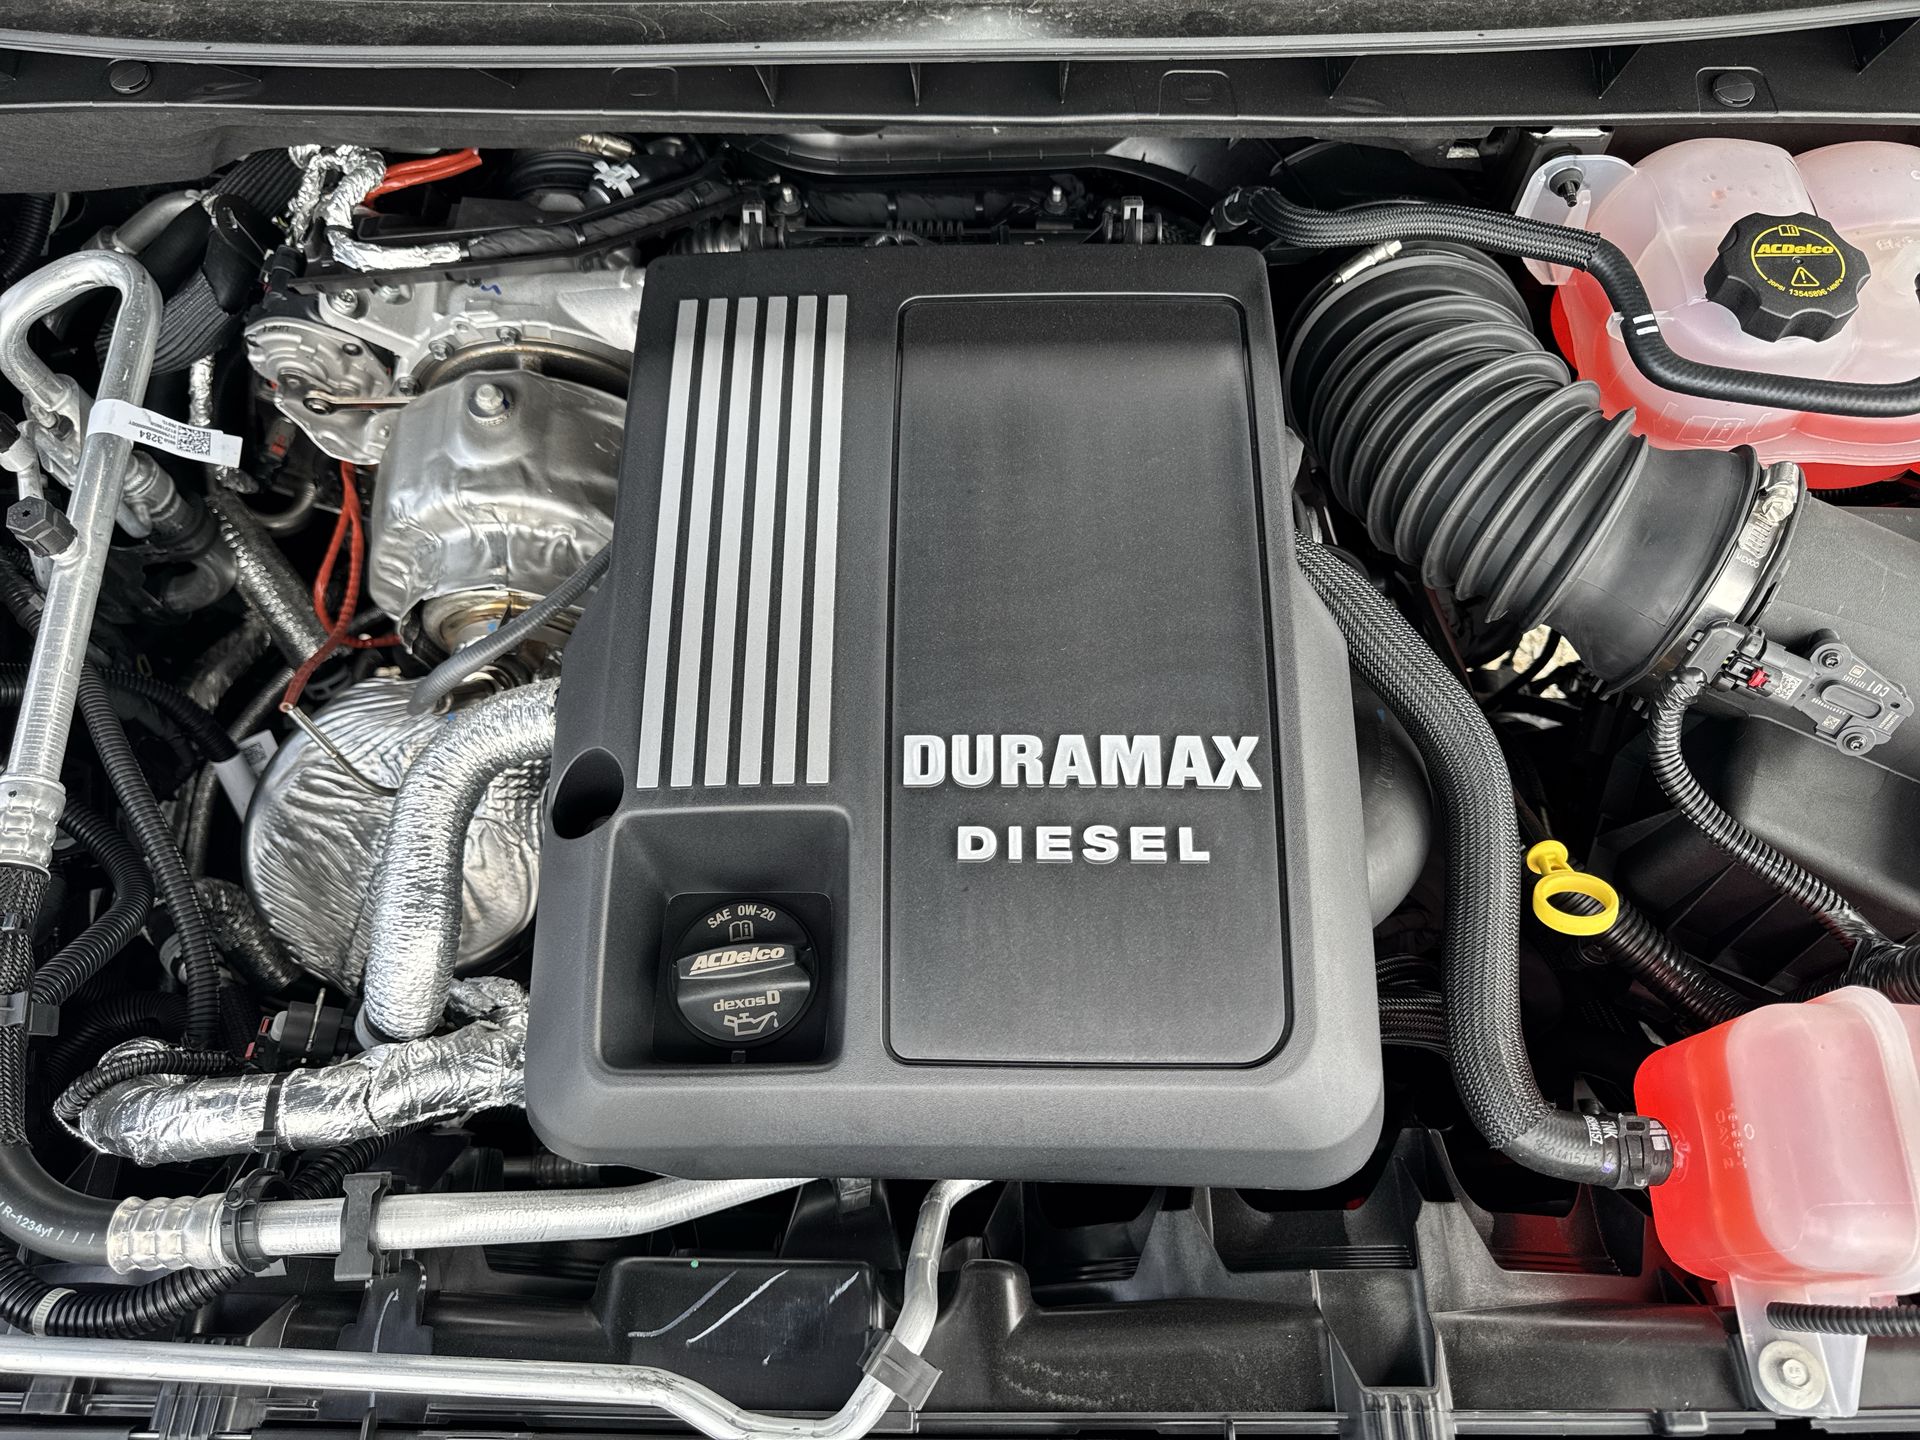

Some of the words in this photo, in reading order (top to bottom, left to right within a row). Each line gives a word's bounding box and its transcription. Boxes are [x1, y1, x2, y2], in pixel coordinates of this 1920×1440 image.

[1757, 243, 1834, 254] ACDelco
[1788, 288, 1828, 298] 13545896
[139, 430, 164, 445] 3284
[903, 734, 1262, 790] DURAMAX
[957, 825, 1210, 864] DIESEL
[707, 908, 732, 929] SAE
[737, 904, 777, 922] 0W-20
[690, 947, 785, 972] ACDelco
[2, 1205, 54, 1238] R-1234yf
